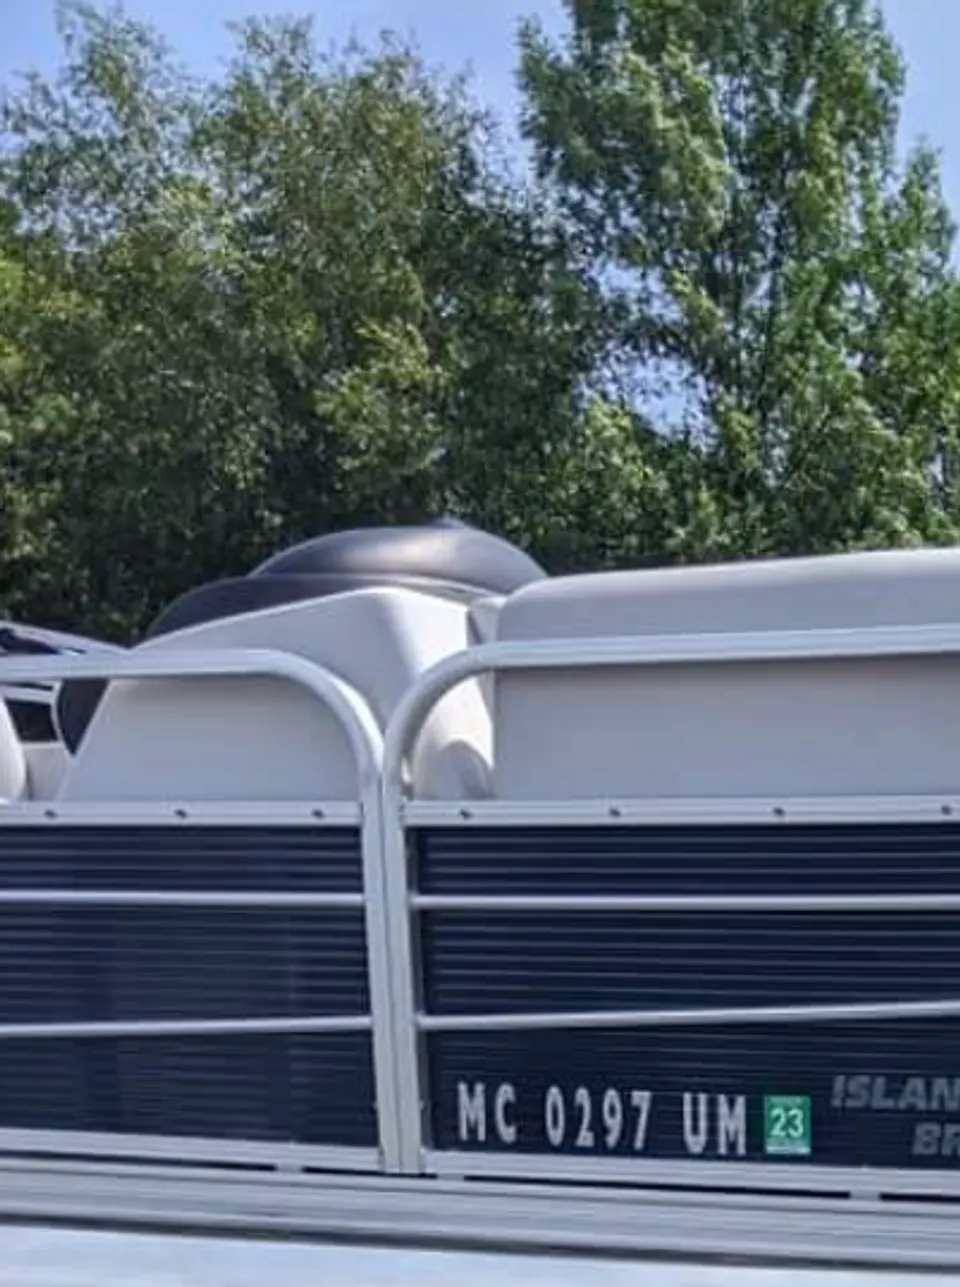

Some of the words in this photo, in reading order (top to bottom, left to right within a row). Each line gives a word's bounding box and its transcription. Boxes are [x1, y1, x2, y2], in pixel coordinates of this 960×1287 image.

[457, 1081, 517, 1144] MC
[546, 1085, 652, 1149] 0297
[682, 1091, 747, 1155] UM
[769, 1108, 804, 1138] 23
